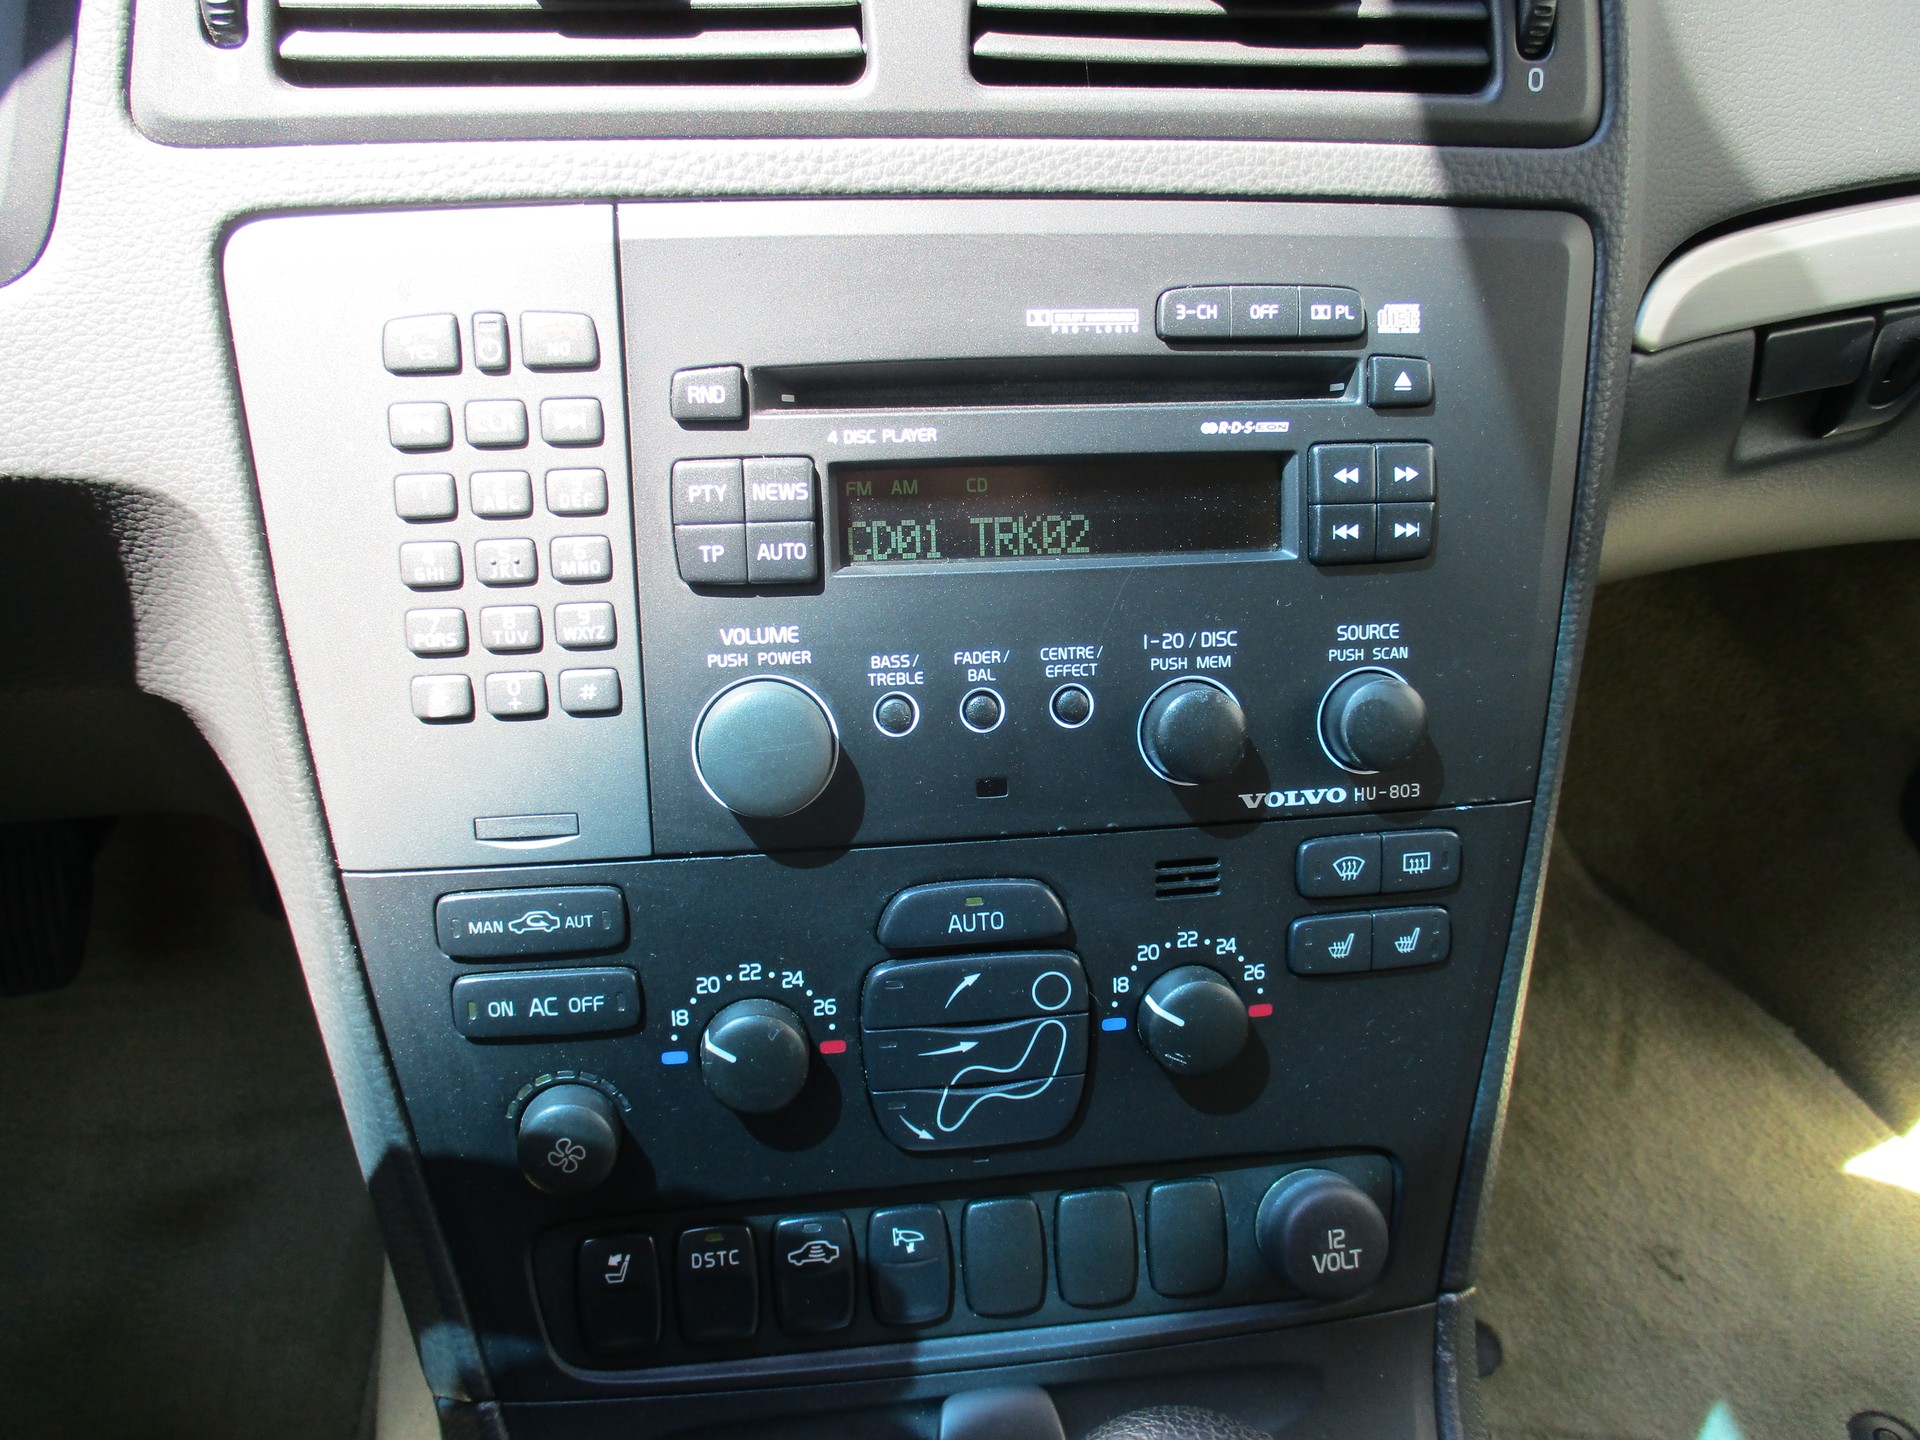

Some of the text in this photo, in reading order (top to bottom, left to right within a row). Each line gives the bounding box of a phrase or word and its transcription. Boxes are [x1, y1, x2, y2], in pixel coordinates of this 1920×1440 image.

[1528, 67, 1544, 93] 0
[1175, 304, 1218, 320] 3-CH
[1249, 304, 1280, 320] OFF
[1335, 304, 1355, 320] PL
[407, 345, 439, 361] YES
[545, 342, 572, 357] NO
[687, 386, 726, 404] RND
[827, 428, 938, 445] 4 DISC PLAYER
[688, 484, 728, 503] PTY
[752, 482, 809, 501] NEWS
[845, 478, 988, 496] FM AM CD
[482, 495, 521, 510] ABC
[558, 493, 596, 508] DEF
[848, 515, 1090, 560] CD01 TRK02
[498, 547, 511, 564] 5
[573, 542, 587, 560] 6
[699, 545, 725, 563] TP
[756, 542, 807, 561] AUTO
[414, 566, 445, 582] GHI
[489, 564, 525, 579] JKL
[561, 560, 602, 576] MNO
[427, 616, 441, 633] 7
[502, 613, 517, 631] 8
[577, 608, 591, 626] 9
[413, 633, 459, 648] PQRS
[492, 630, 530, 645] TUV
[562, 625, 607, 641] WXYZ
[719, 626, 800, 646] VOLUME
[1201, 630, 1238, 648] DISC
[1336, 623, 1400, 642] SOURCE
[707, 650, 812, 668] PUSH POWER
[1150, 655, 1232, 671] PUSH MEM
[1328, 647, 1409, 662] PUSH SCAN
[867, 671, 924, 687] TREBLE
[967, 668, 997, 682] BAL
[1045, 664, 1098, 678] EFFECT
[507, 679, 522, 696] 0
[579, 683, 598, 700] #
[1238, 783, 1420, 809] VOLVO HU-803
[468, 915, 594, 934] MAN AUT
[948, 911, 1005, 934] AUTO
[1112, 931, 1265, 994] 18 20 22 24 26
[671, 963, 837, 1027] 18 20 22 24 26
[488, 995, 605, 1018] ON AC OFF
[1327, 1229, 1346, 1250] 12
[691, 1250, 740, 1269] DSTC
[1312, 1248, 1363, 1274] VOLT
